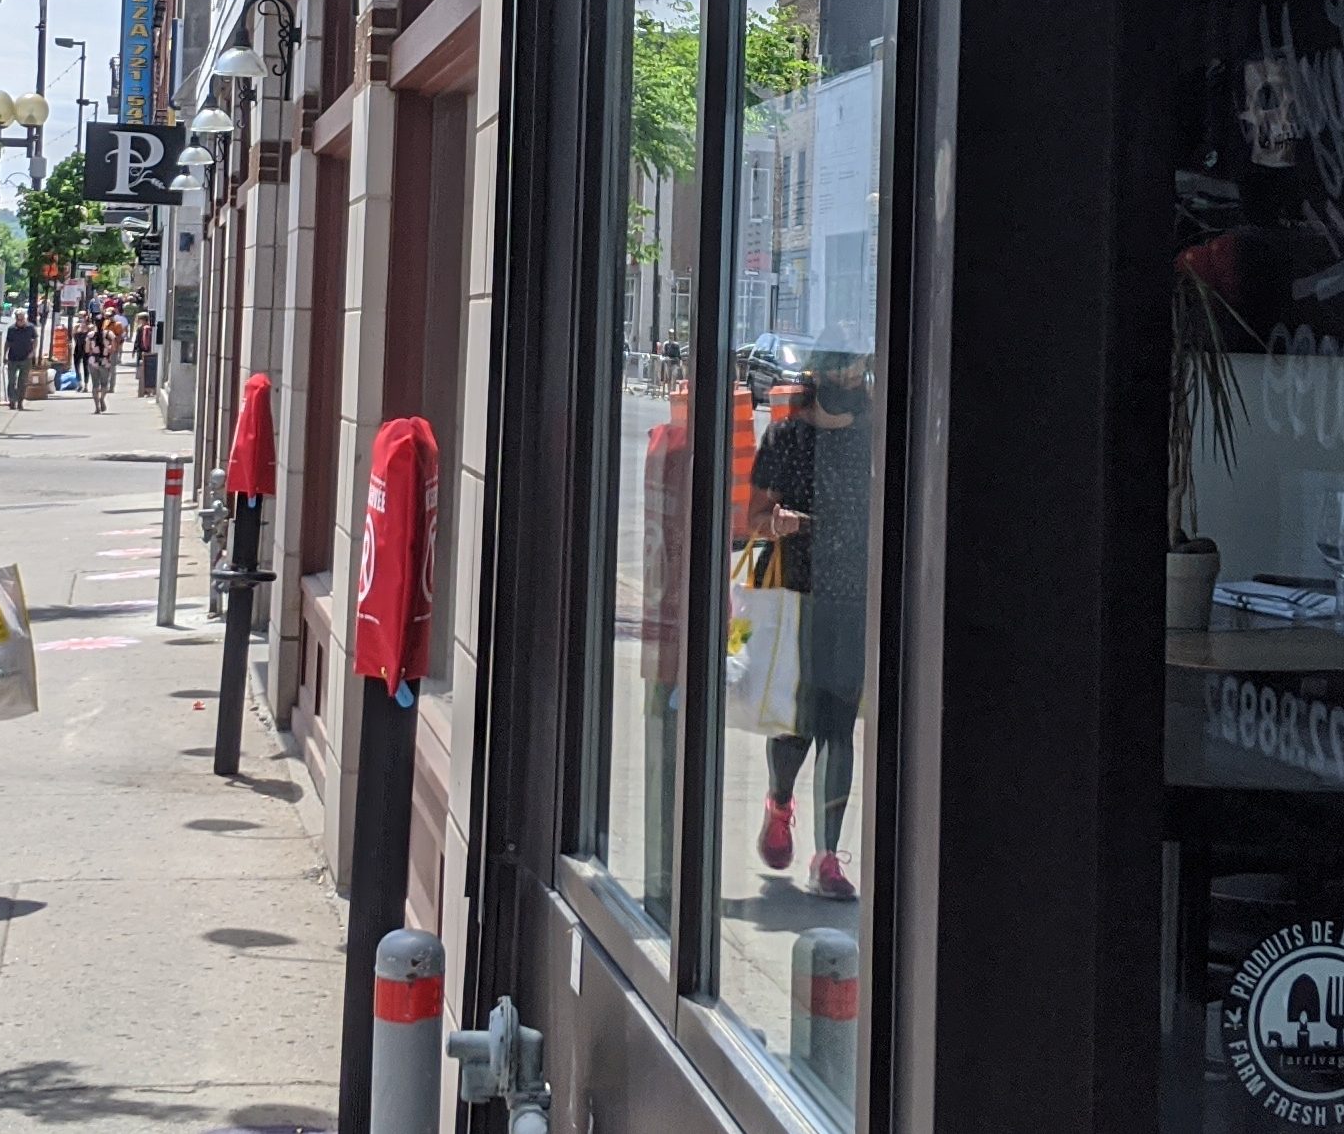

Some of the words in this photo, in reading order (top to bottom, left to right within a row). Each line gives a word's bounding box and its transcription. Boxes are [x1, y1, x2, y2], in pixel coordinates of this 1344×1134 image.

[126, 43, 147, 125] 721-54
[1230, 924, 1305, 1000] PRODUITS
[1311, 920, 1335, 944] DE
[1229, 1039, 1267, 1098] FARM
[1263, 1090, 1327, 1127] FRESH
